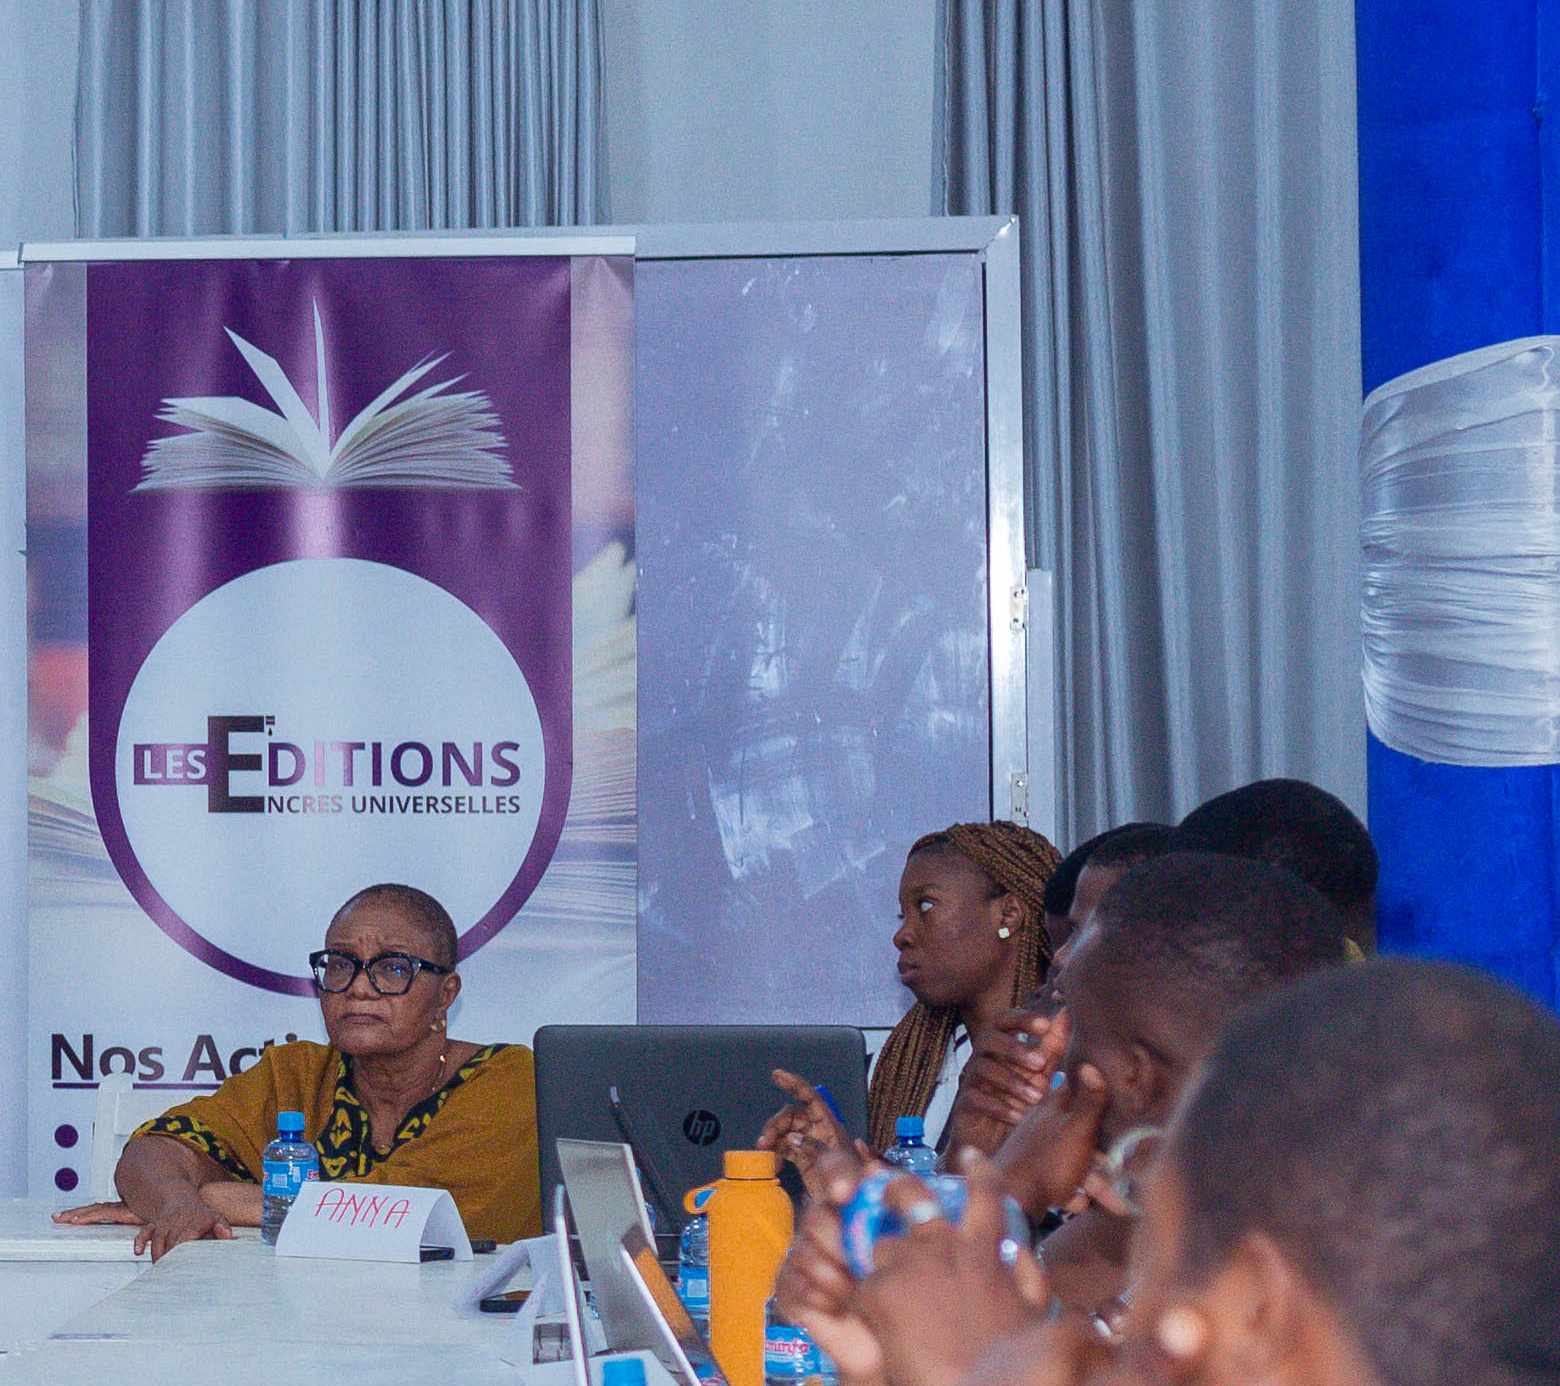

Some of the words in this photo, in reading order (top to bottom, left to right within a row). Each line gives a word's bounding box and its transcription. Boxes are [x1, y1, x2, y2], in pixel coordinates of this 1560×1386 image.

[143, 749, 207, 779] LES
[351, 795, 521, 813] UNIVERSELLES
[51, 1033, 165, 1081] Nos
[314, 1187, 411, 1229] ANNA
